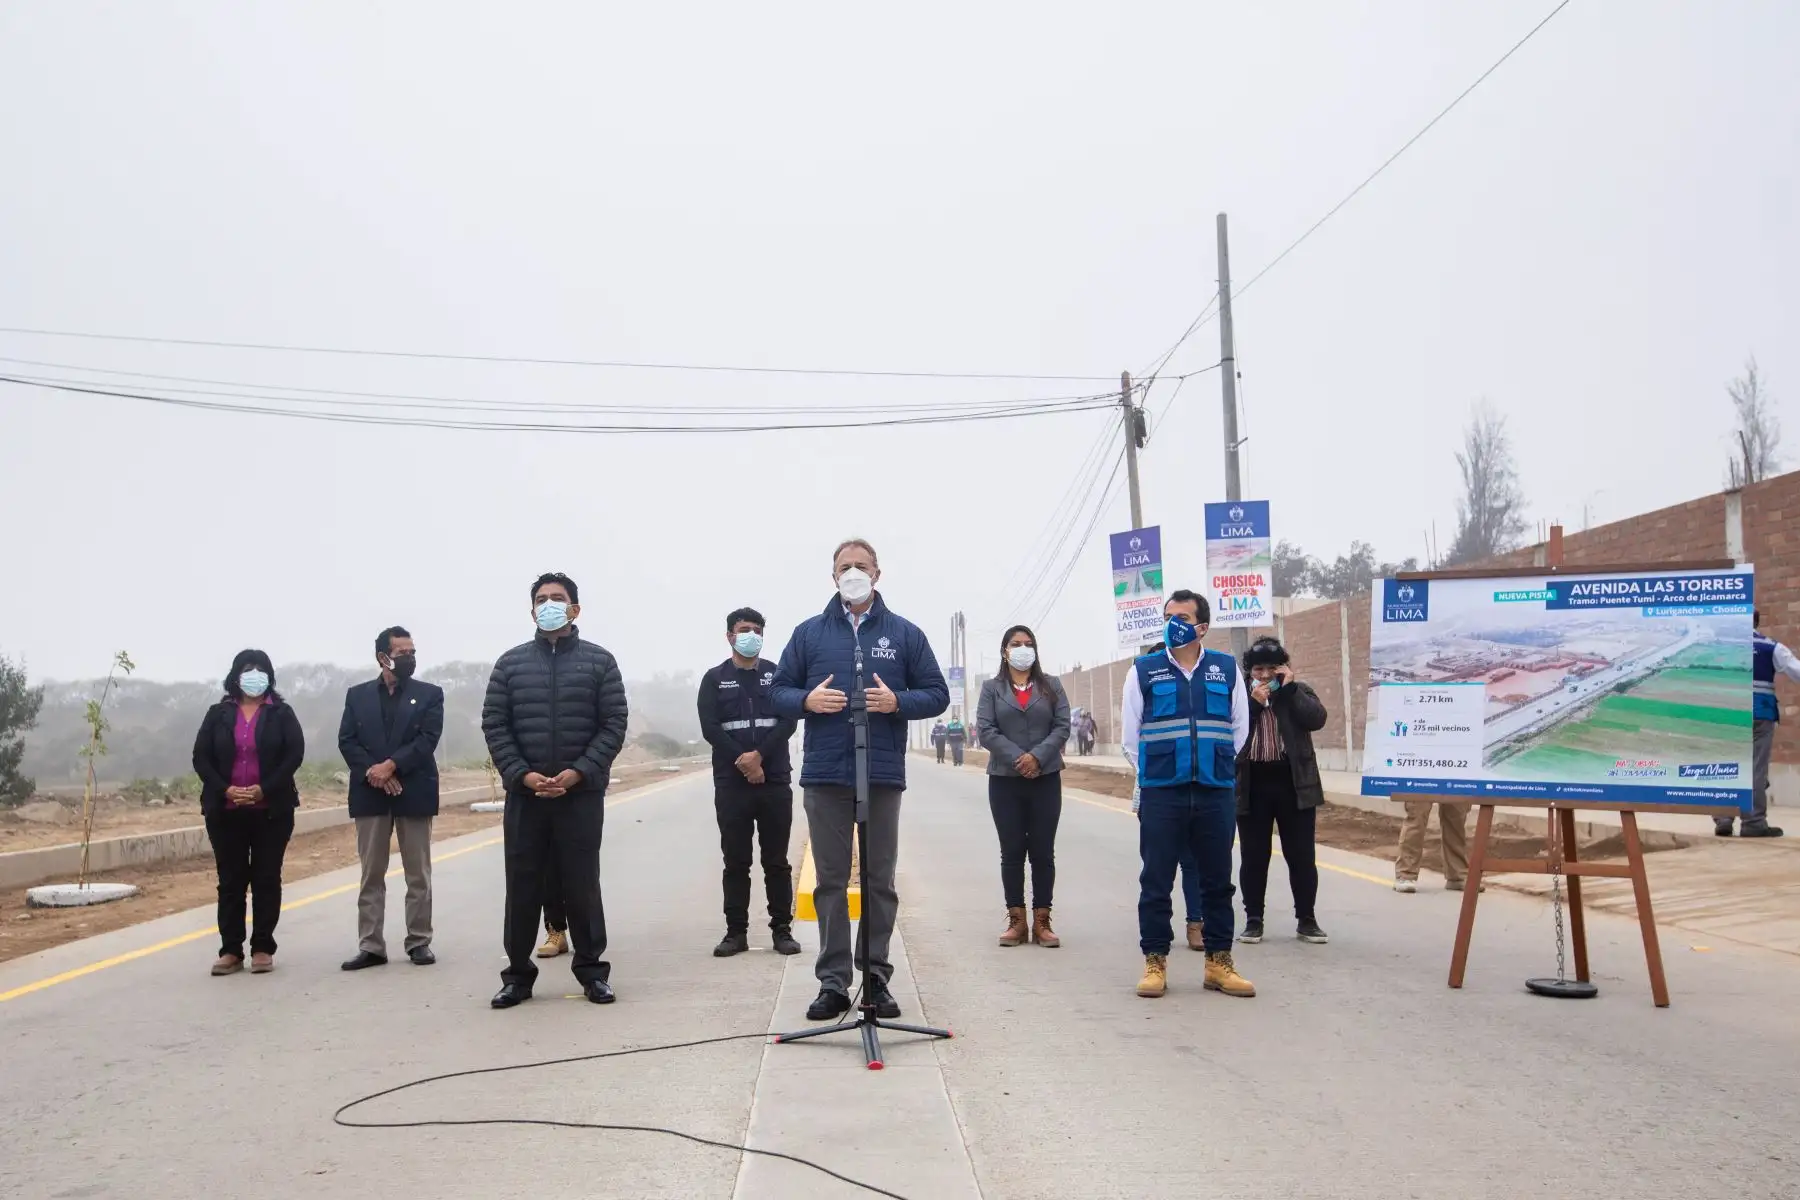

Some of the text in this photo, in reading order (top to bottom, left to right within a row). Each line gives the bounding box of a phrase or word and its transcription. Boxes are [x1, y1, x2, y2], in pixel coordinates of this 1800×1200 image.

[1221, 527, 1254, 537] LIMA
[1124, 555, 1150, 566] LIMA
[1570, 578, 1744, 596] AVENIDA LAS TORRES
[1499, 591, 1553, 600] NUEVA PISTA
[1569, 597, 1598, 605] Tramo:
[1600, 596, 1631, 604] Puente
[1633, 595, 1655, 603] Tumi
[1699, 592, 1746, 602] Jicamarca
[1219, 598, 1262, 610] LIMA
[1123, 607, 1157, 620] AVENIDA
[1235, 609, 1266, 620] contigo
[1387, 609, 1424, 619] LIMA
[1656, 607, 1704, 616] Lurigancho
[1712, 605, 1747, 614] Chosica
[1118, 621, 1132, 631] LAS
[1133, 617, 1164, 629] TORRES
[872, 650, 896, 660] LIMA
[1419, 695, 1453, 703] 2.71 km
[1681, 765, 1705, 779] Jorge
